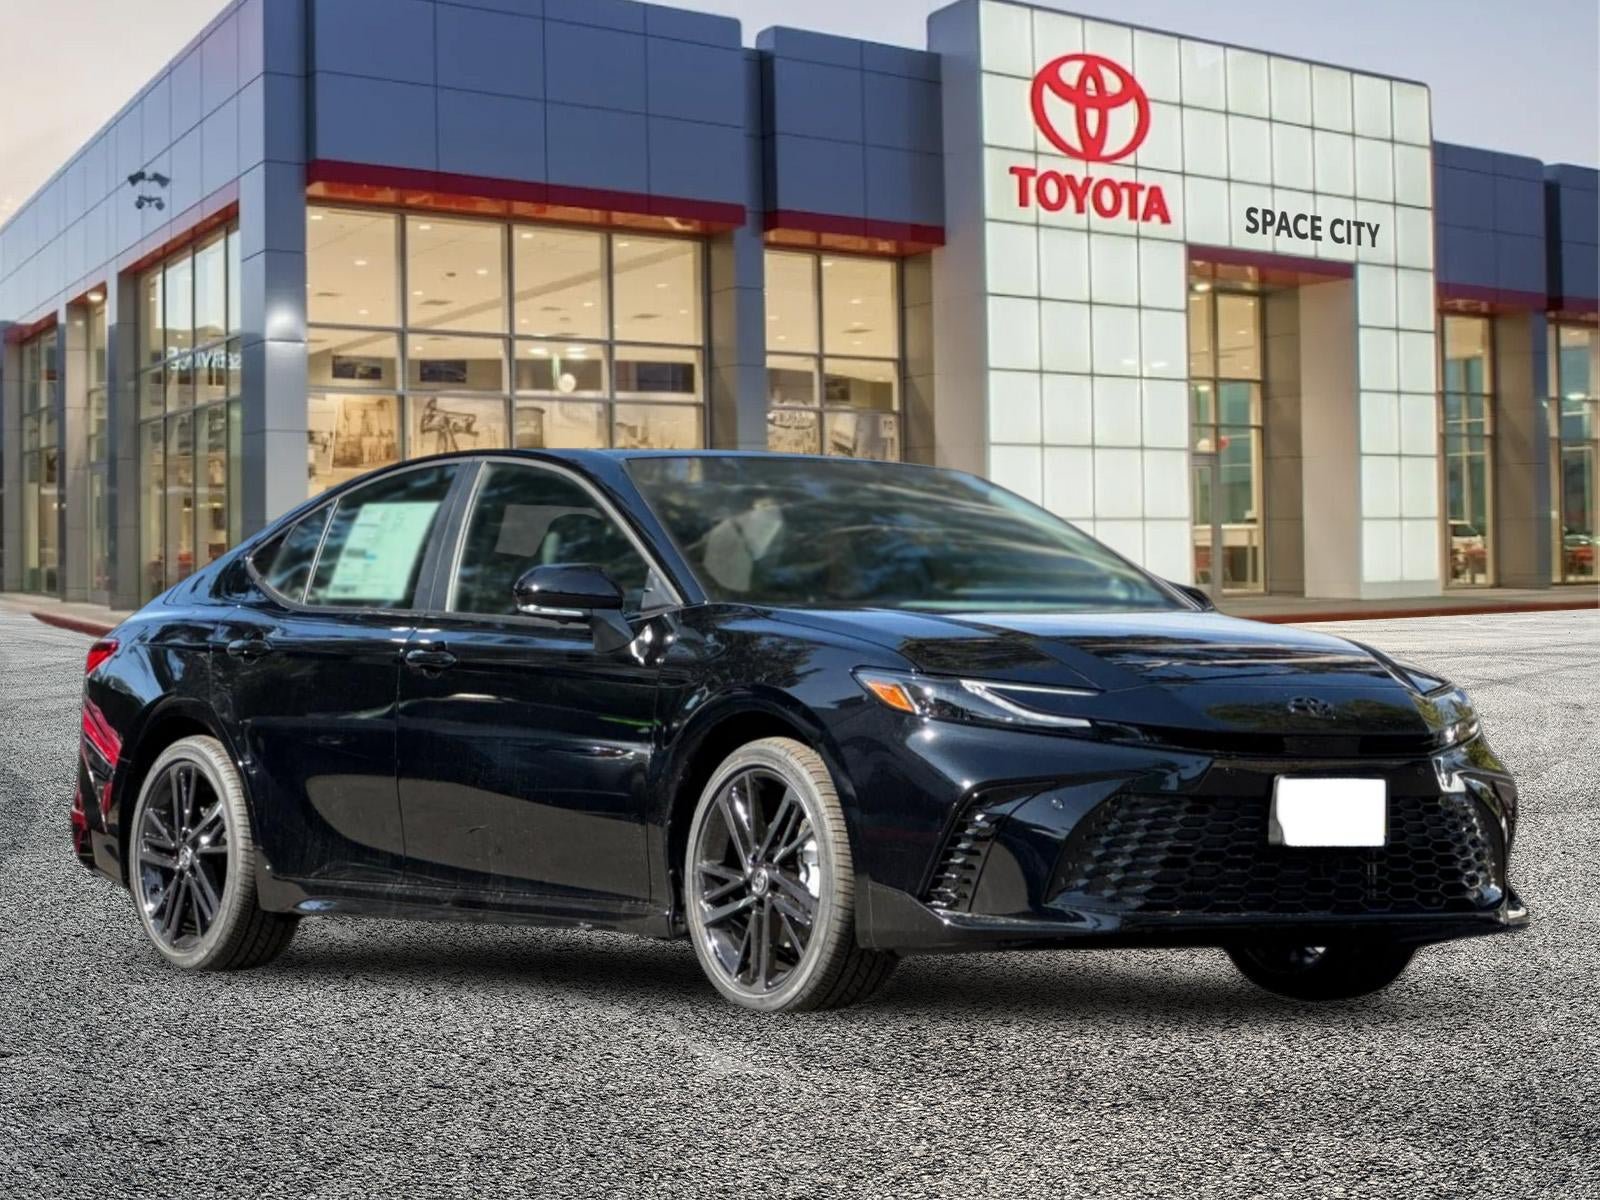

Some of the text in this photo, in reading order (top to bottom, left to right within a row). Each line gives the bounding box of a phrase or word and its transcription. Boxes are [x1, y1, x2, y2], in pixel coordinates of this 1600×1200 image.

[1009, 166, 1171, 225] TOYOTA
[1245, 206, 1382, 248] SPACE CITY
